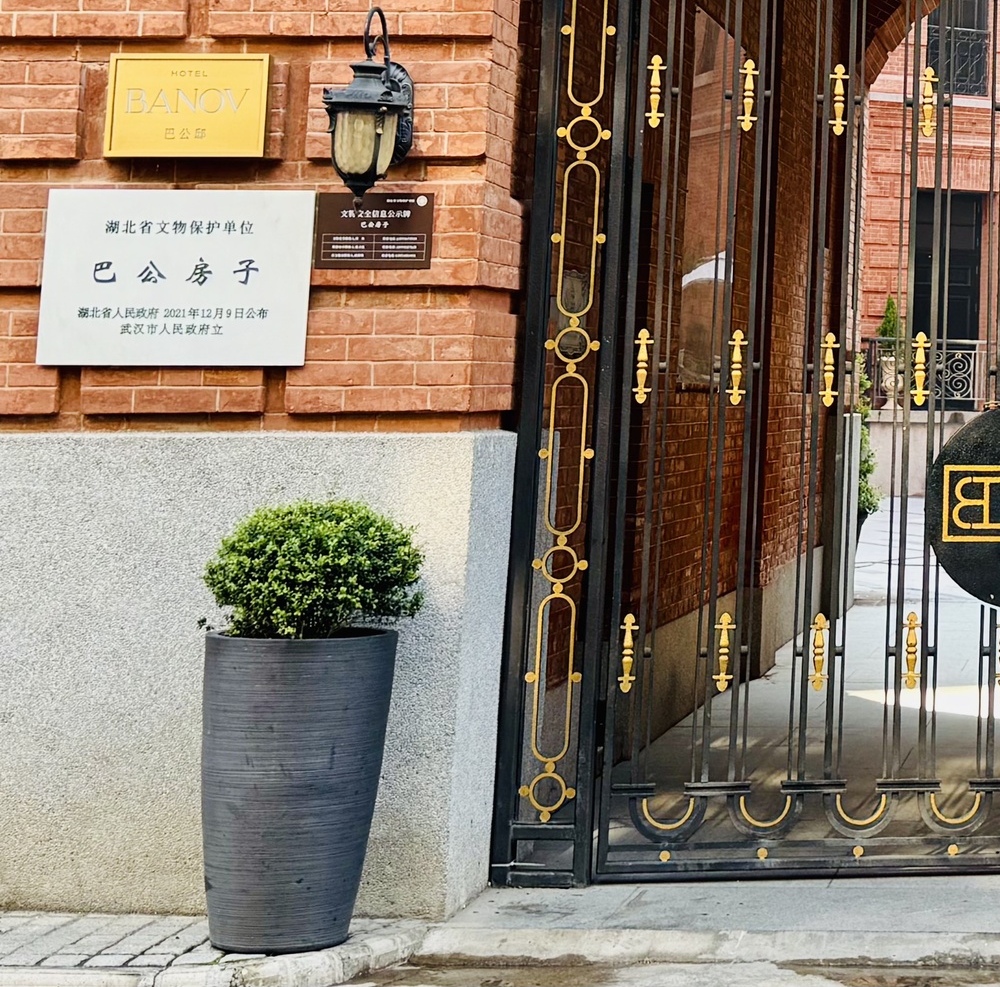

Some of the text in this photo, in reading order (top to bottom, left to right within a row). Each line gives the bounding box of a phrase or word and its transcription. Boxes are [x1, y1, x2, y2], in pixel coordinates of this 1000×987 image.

[171, 70, 208, 78] HOTEL
[125, 88, 250, 114] BANOV
[164, 127, 206, 140] 巴公邸
[105, 220, 254, 235] 湖北省文物保护单位
[93, 257, 259, 286] 巴公房子
[77, 306, 269, 320] 湖北省人民政府 2021年12月9日公布
[119, 323, 223, 336] 武汉市人民政府立
